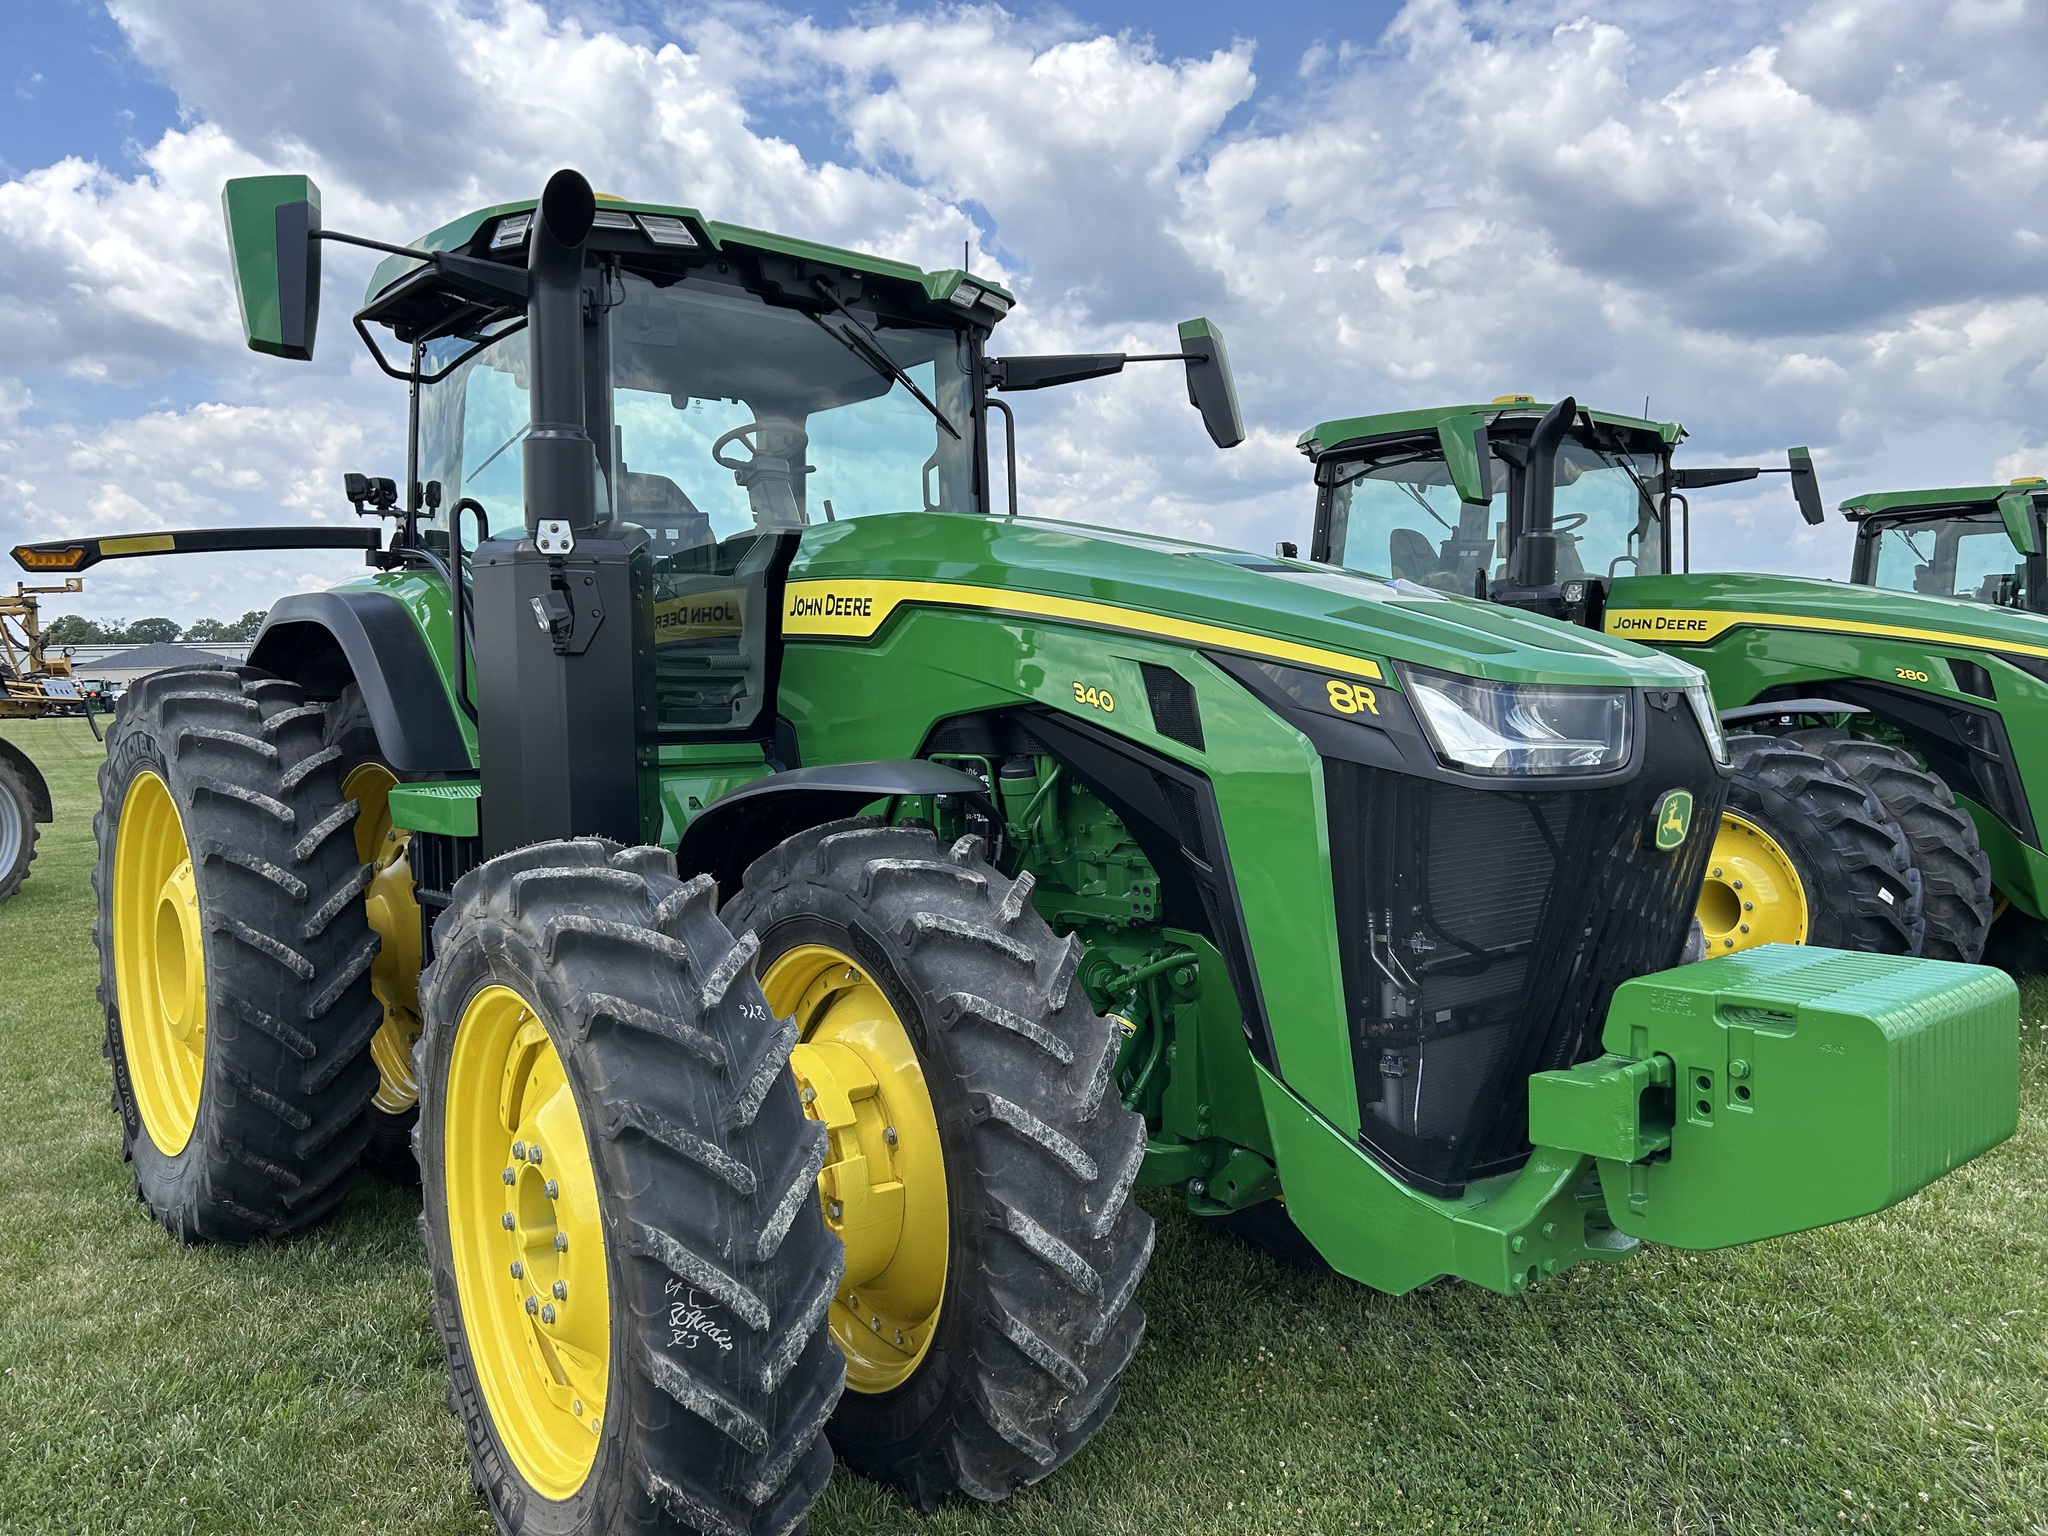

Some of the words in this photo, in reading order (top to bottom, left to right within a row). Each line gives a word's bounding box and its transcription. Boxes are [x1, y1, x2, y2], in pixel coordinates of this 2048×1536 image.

[789, 594, 823, 617] JOHN
[825, 593, 873, 617] DEERE
[1613, 616, 1652, 630] JOHN
[1655, 616, 1708, 631] DEERE
[1894, 667, 1929, 683] 280
[1072, 681, 1115, 713] 340
[1326, 680, 1380, 715] 8R
